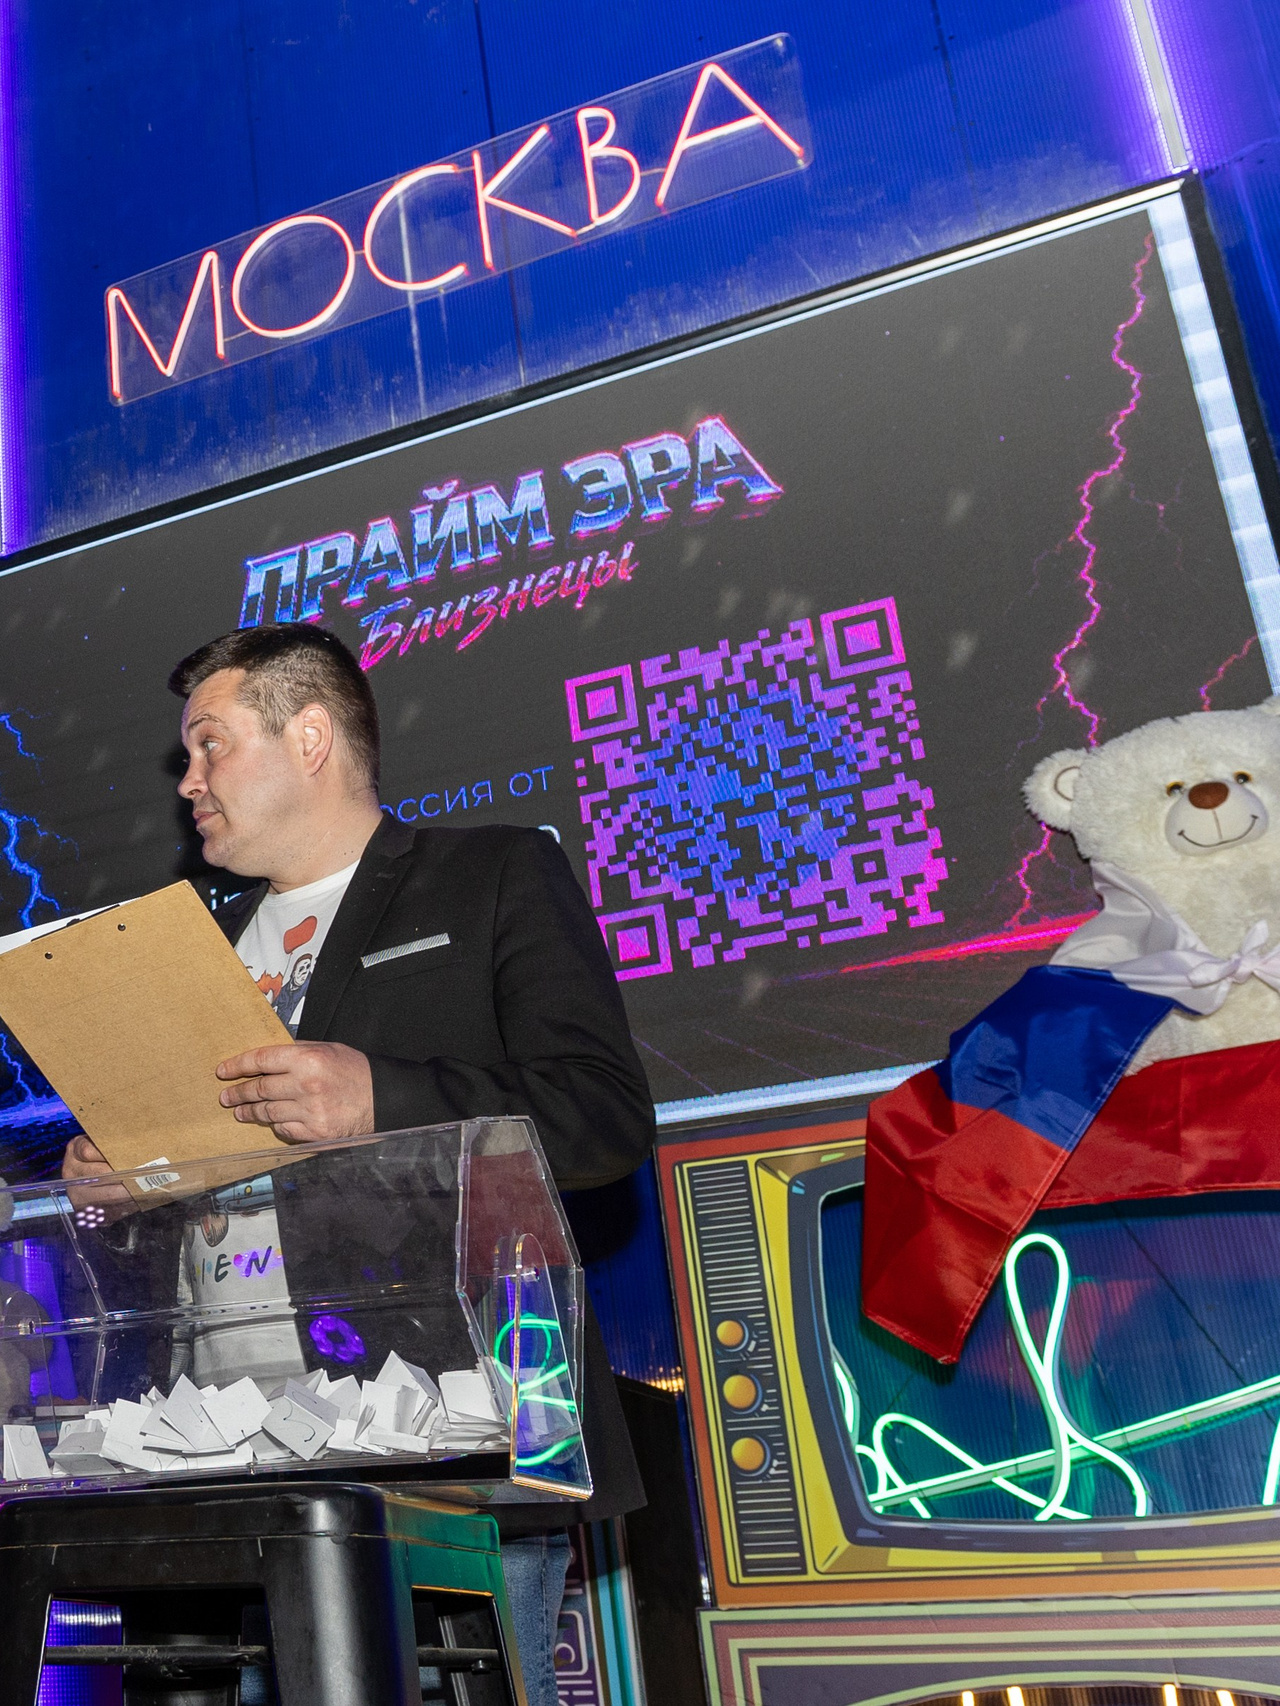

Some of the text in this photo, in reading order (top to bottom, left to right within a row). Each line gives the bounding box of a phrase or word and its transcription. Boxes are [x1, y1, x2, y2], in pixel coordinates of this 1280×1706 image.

[105, 61, 805, 400] МОСКВА
[238, 415, 783, 629] ПРАЙМ ЭРА
[358, 541, 636, 672] Близнецы
[509, 765, 554, 797] ОТ
